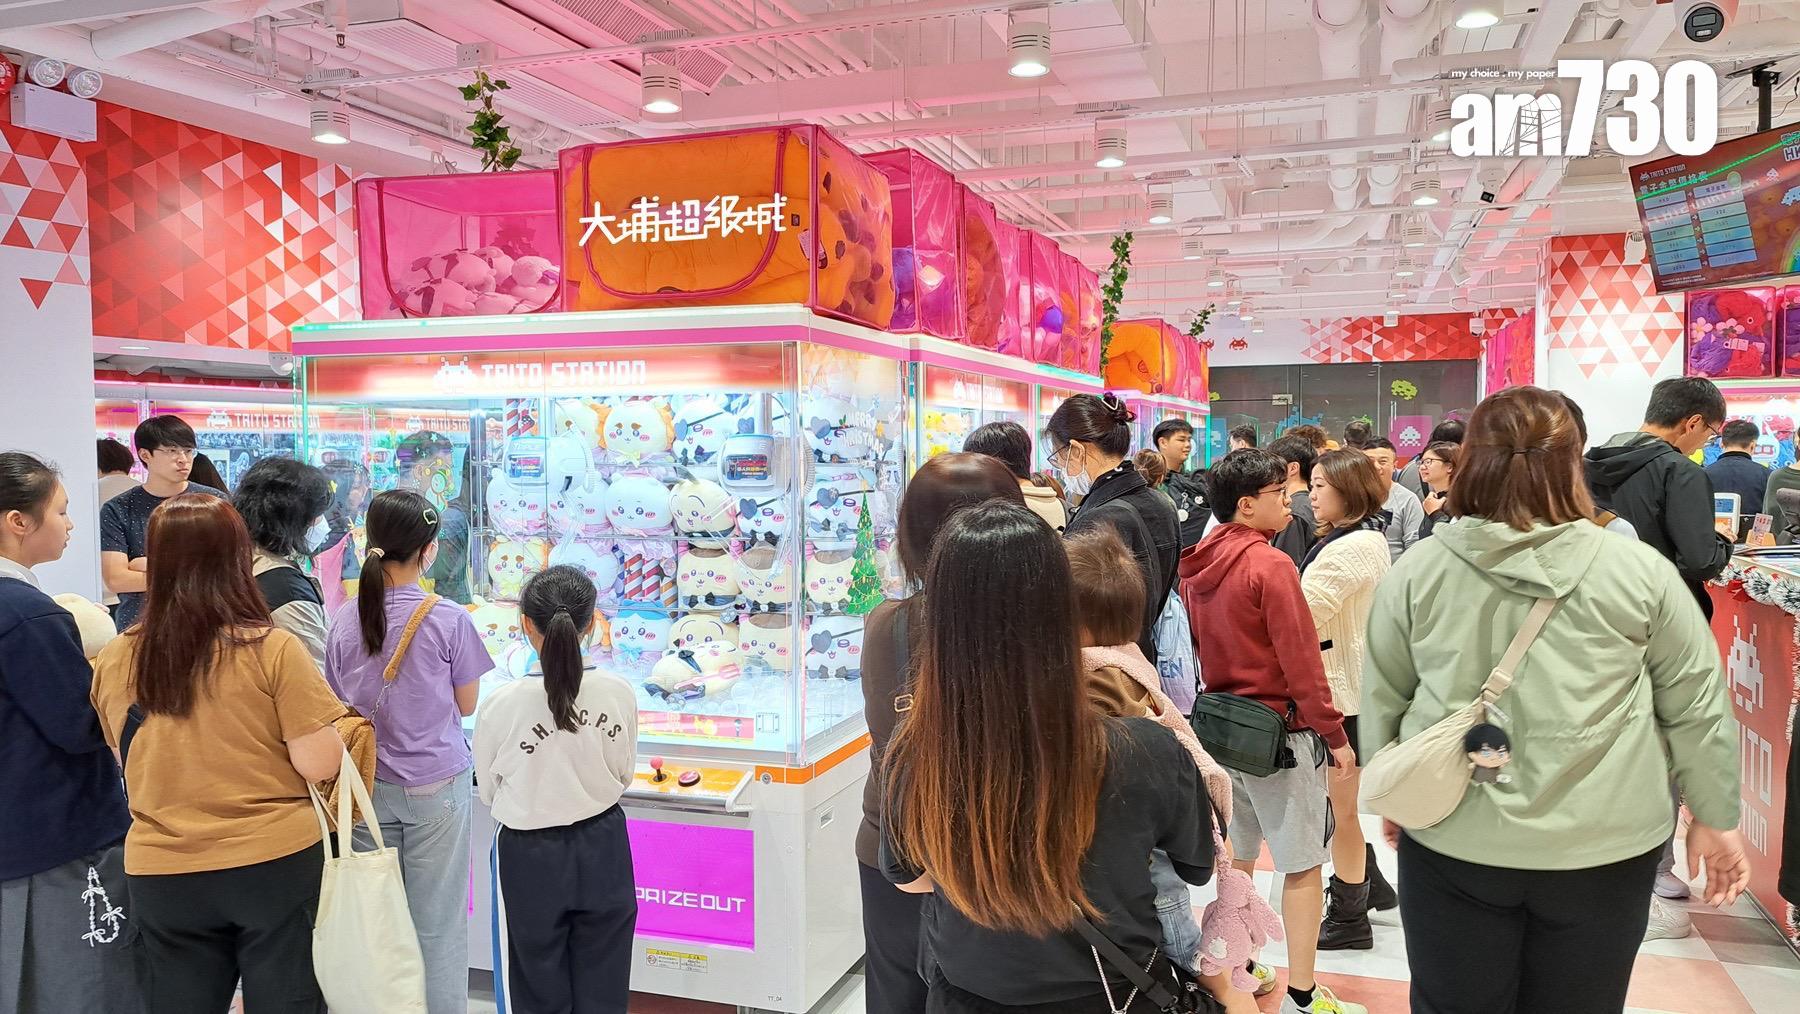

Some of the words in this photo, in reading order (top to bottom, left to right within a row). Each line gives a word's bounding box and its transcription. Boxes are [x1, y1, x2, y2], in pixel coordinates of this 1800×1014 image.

[481, 363, 544, 387] TAITO
[551, 360, 646, 386] STATION
[234, 413, 270, 428] TAITO
